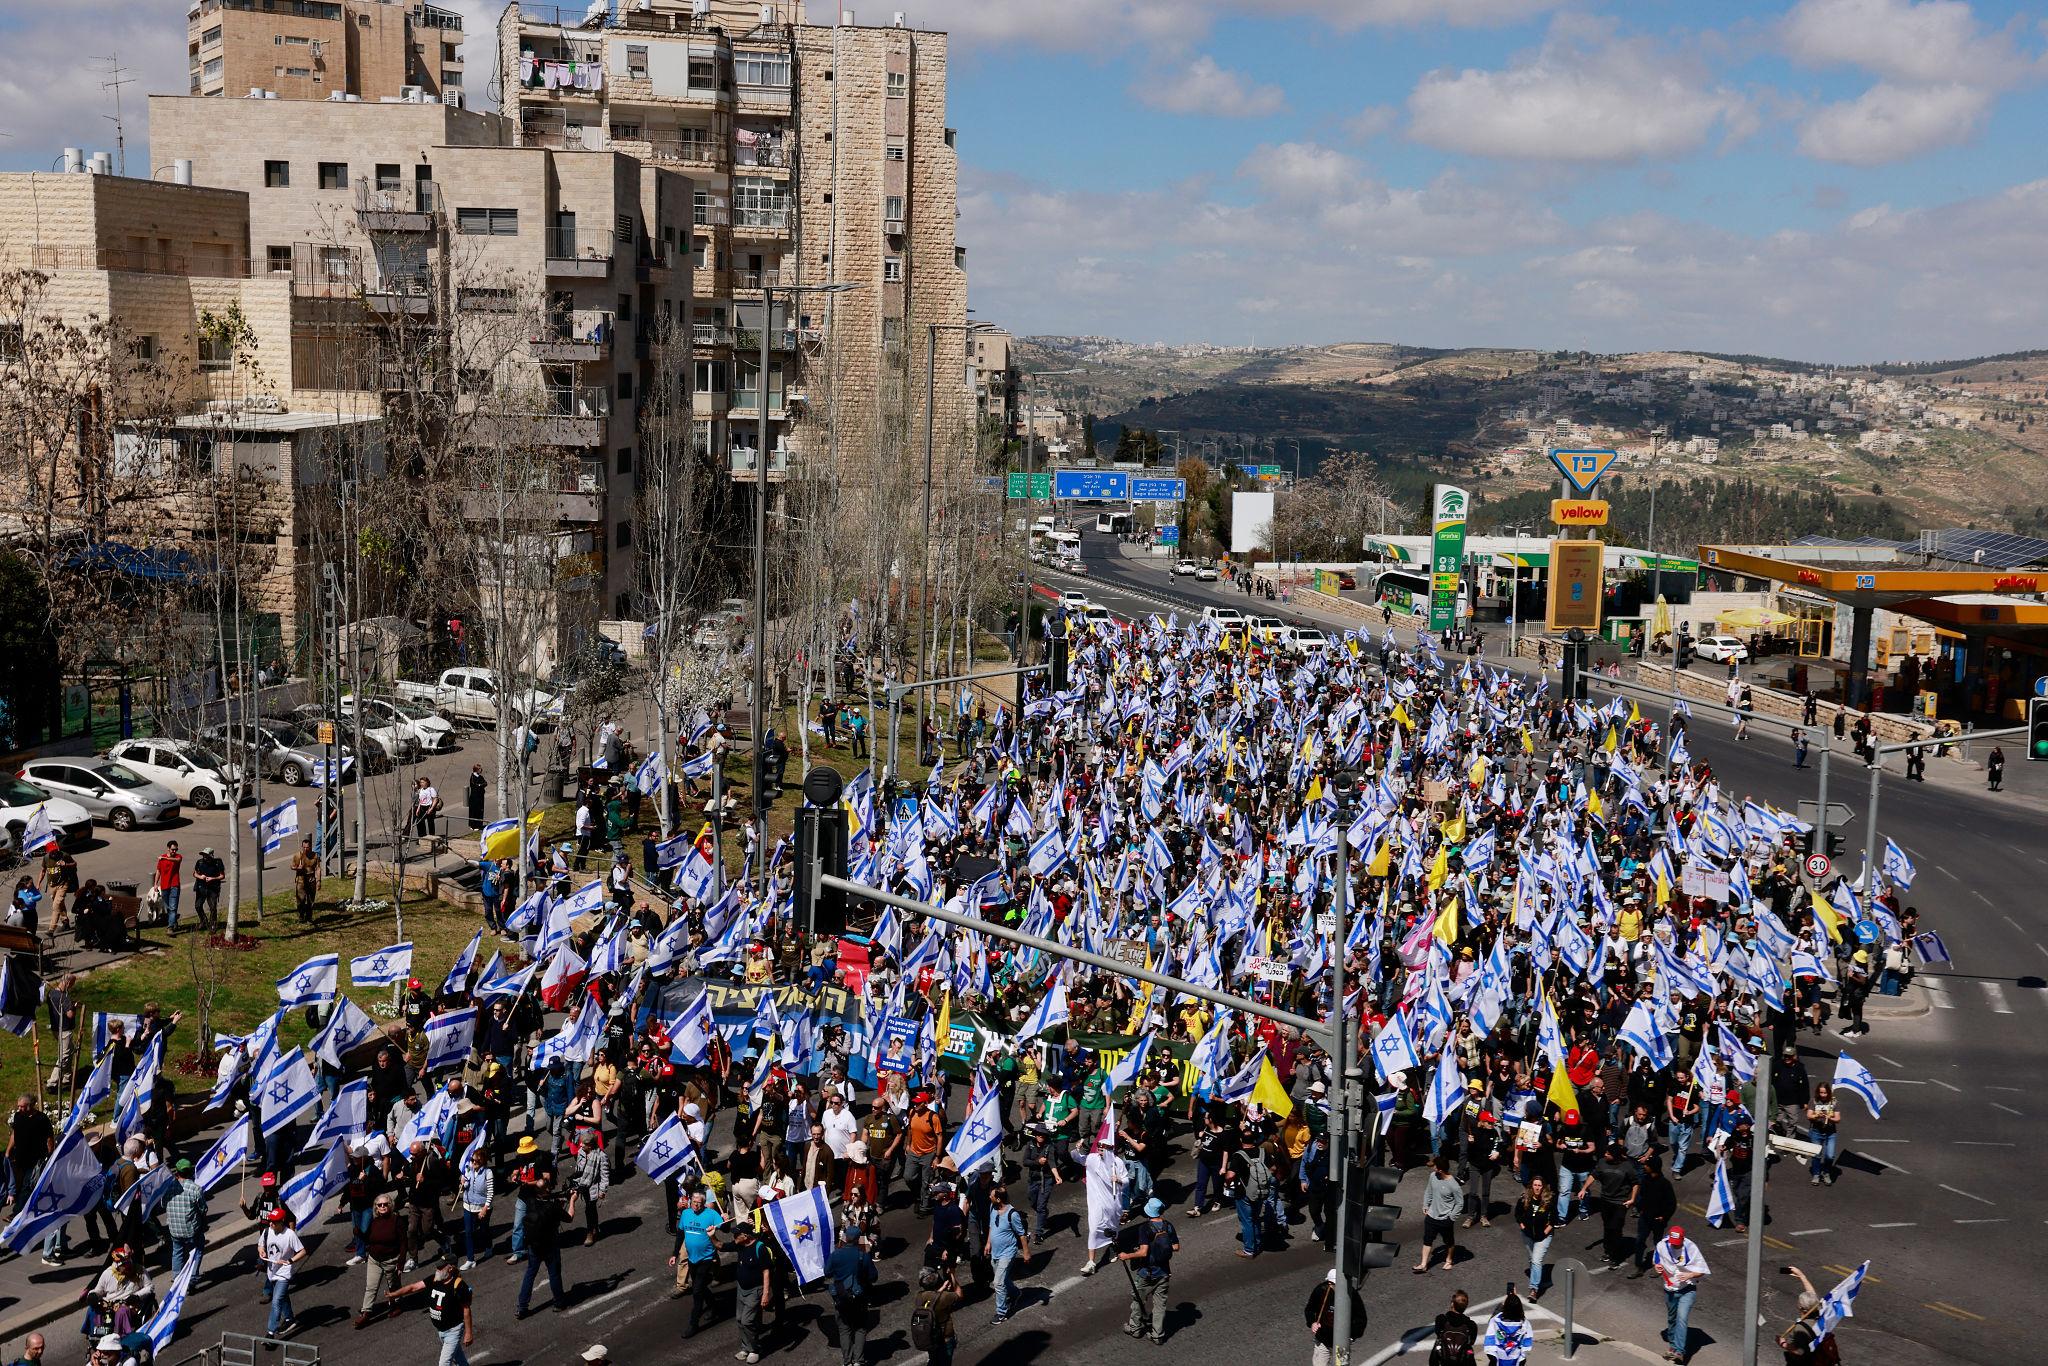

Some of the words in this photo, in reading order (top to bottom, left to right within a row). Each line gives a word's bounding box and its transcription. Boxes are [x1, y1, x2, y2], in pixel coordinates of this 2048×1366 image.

[1572, 456, 1597, 472] פז
[1561, 506, 1603, 520] yellow
[1857, 575, 1875, 589] פז
[1811, 860, 1826, 871] 30
[1103, 941, 1127, 961] WE
[1127, 948, 1146, 963] THE
